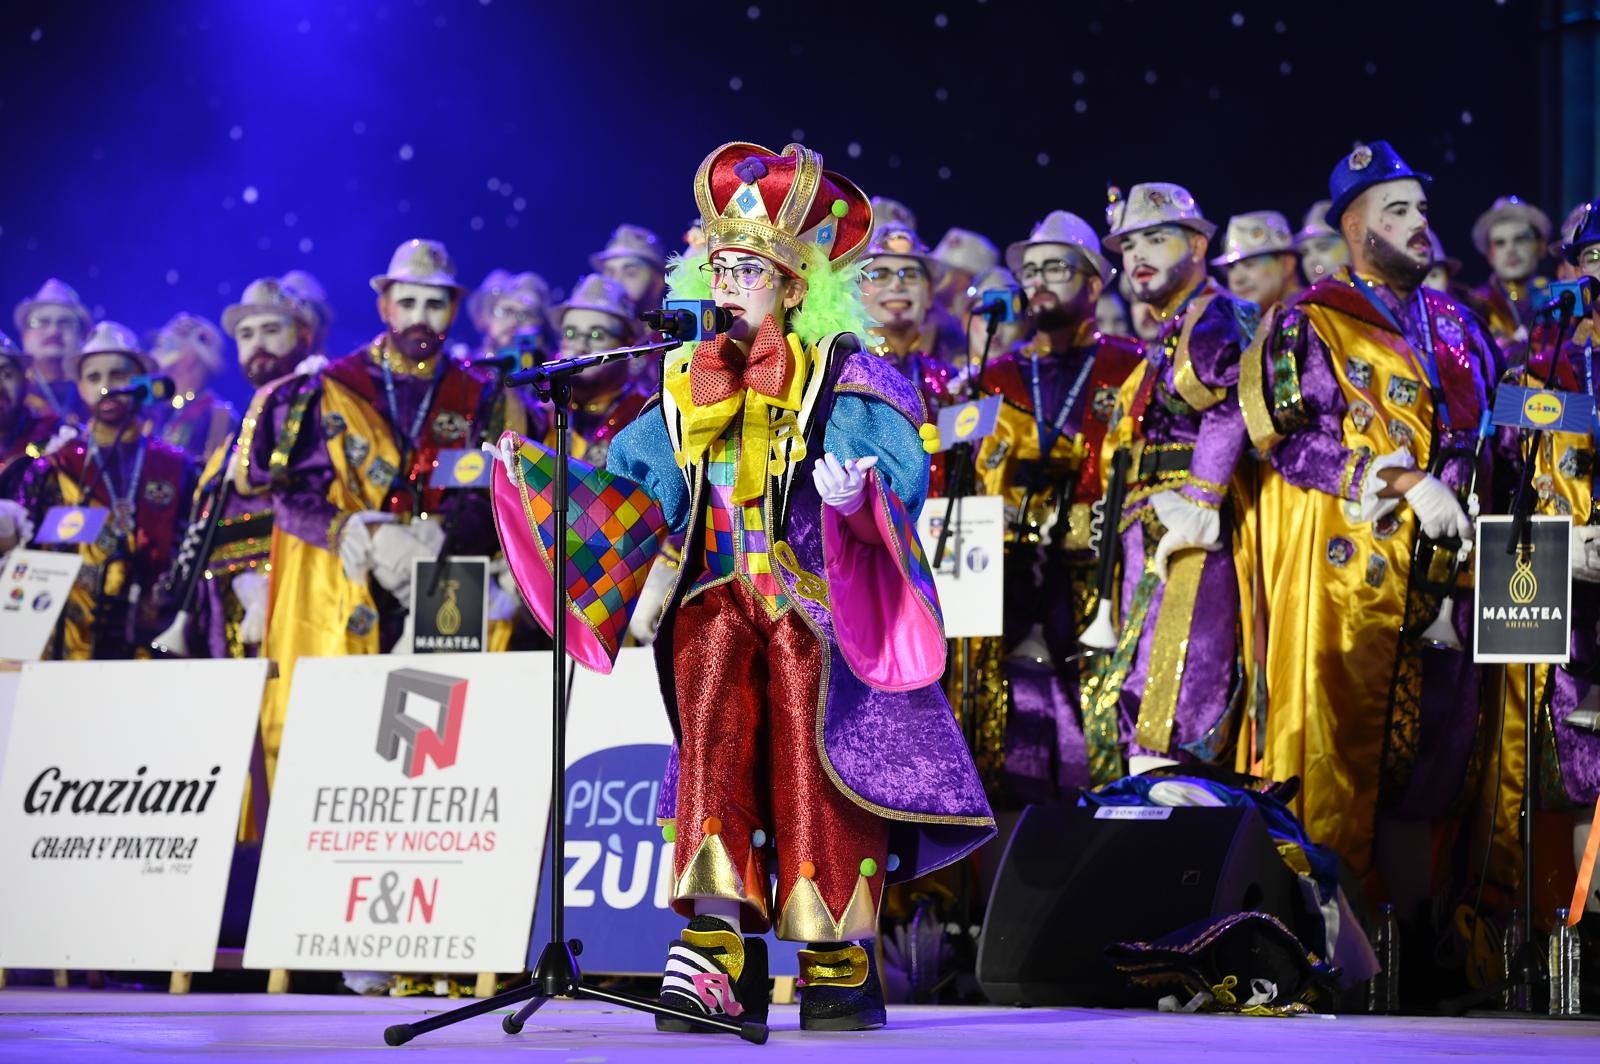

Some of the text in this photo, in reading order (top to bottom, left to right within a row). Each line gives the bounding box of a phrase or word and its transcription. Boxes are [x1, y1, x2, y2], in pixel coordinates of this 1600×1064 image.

[1482, 606, 1562, 620] MAKATEA
[415, 635, 480, 650] MAKATEA
[23, 766, 221, 815] Graziani
[565, 776, 659, 828] PISCI
[313, 786, 499, 823] FERRETERIA
[31, 835, 199, 860] CHAPA Y PINTURA
[307, 830, 496, 852] FELIPE Y NICOLAS
[344, 870, 439, 925] F&N
[295, 933, 476, 959] TRANSPORTES
